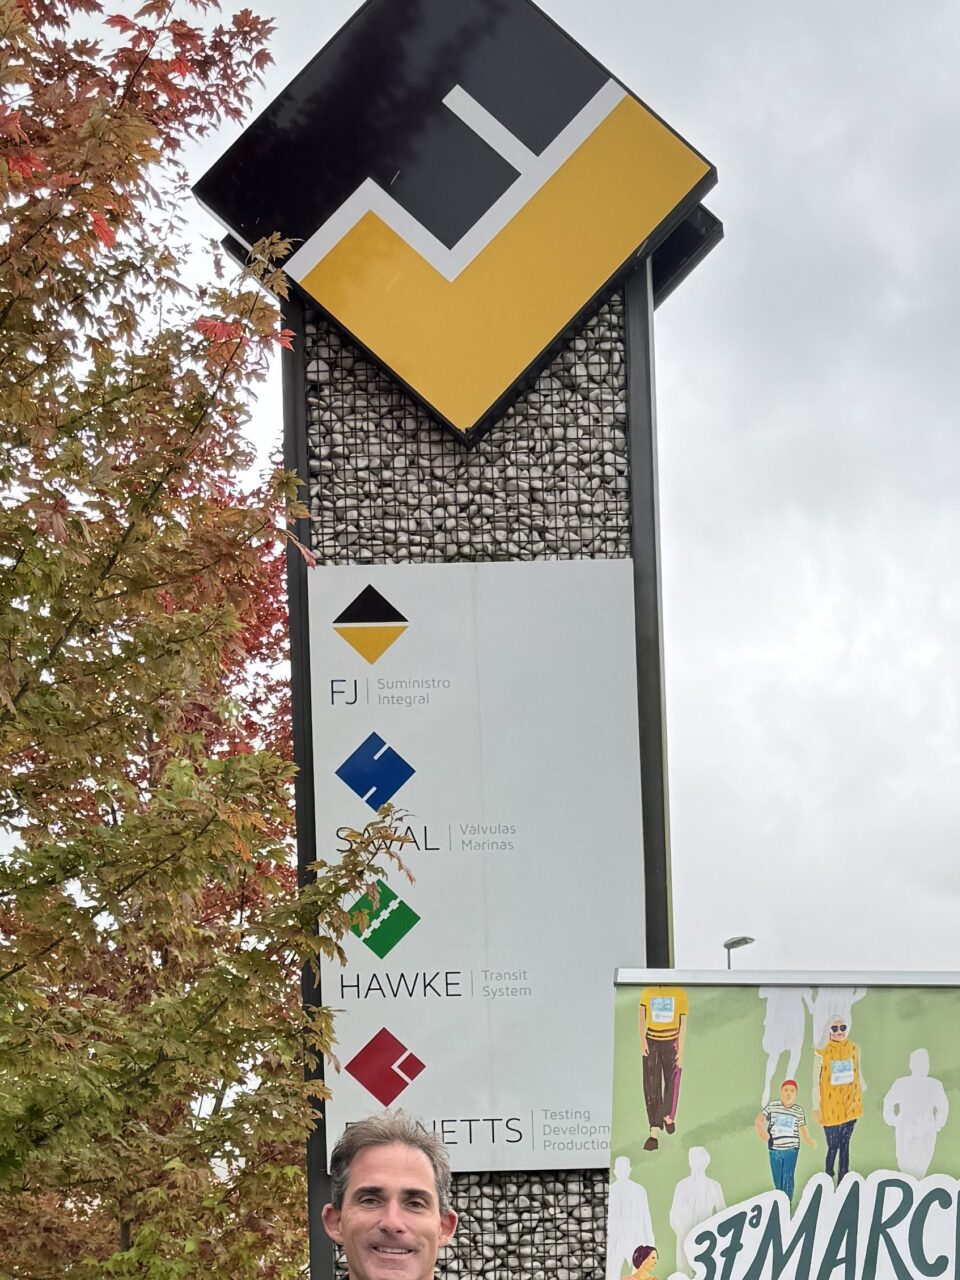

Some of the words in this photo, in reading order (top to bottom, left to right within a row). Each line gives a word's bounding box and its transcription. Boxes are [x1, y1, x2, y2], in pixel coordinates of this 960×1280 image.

[377, 677, 451, 690] Suministro
[331, 679, 358, 705] FJ
[378, 692, 430, 707] Integral
[461, 839, 515, 850] Marinas
[481, 969, 528, 981] Transit
[340, 971, 462, 999] HAWKE
[482, 985, 532, 998] System
[542, 1109, 591, 1121] Testing
